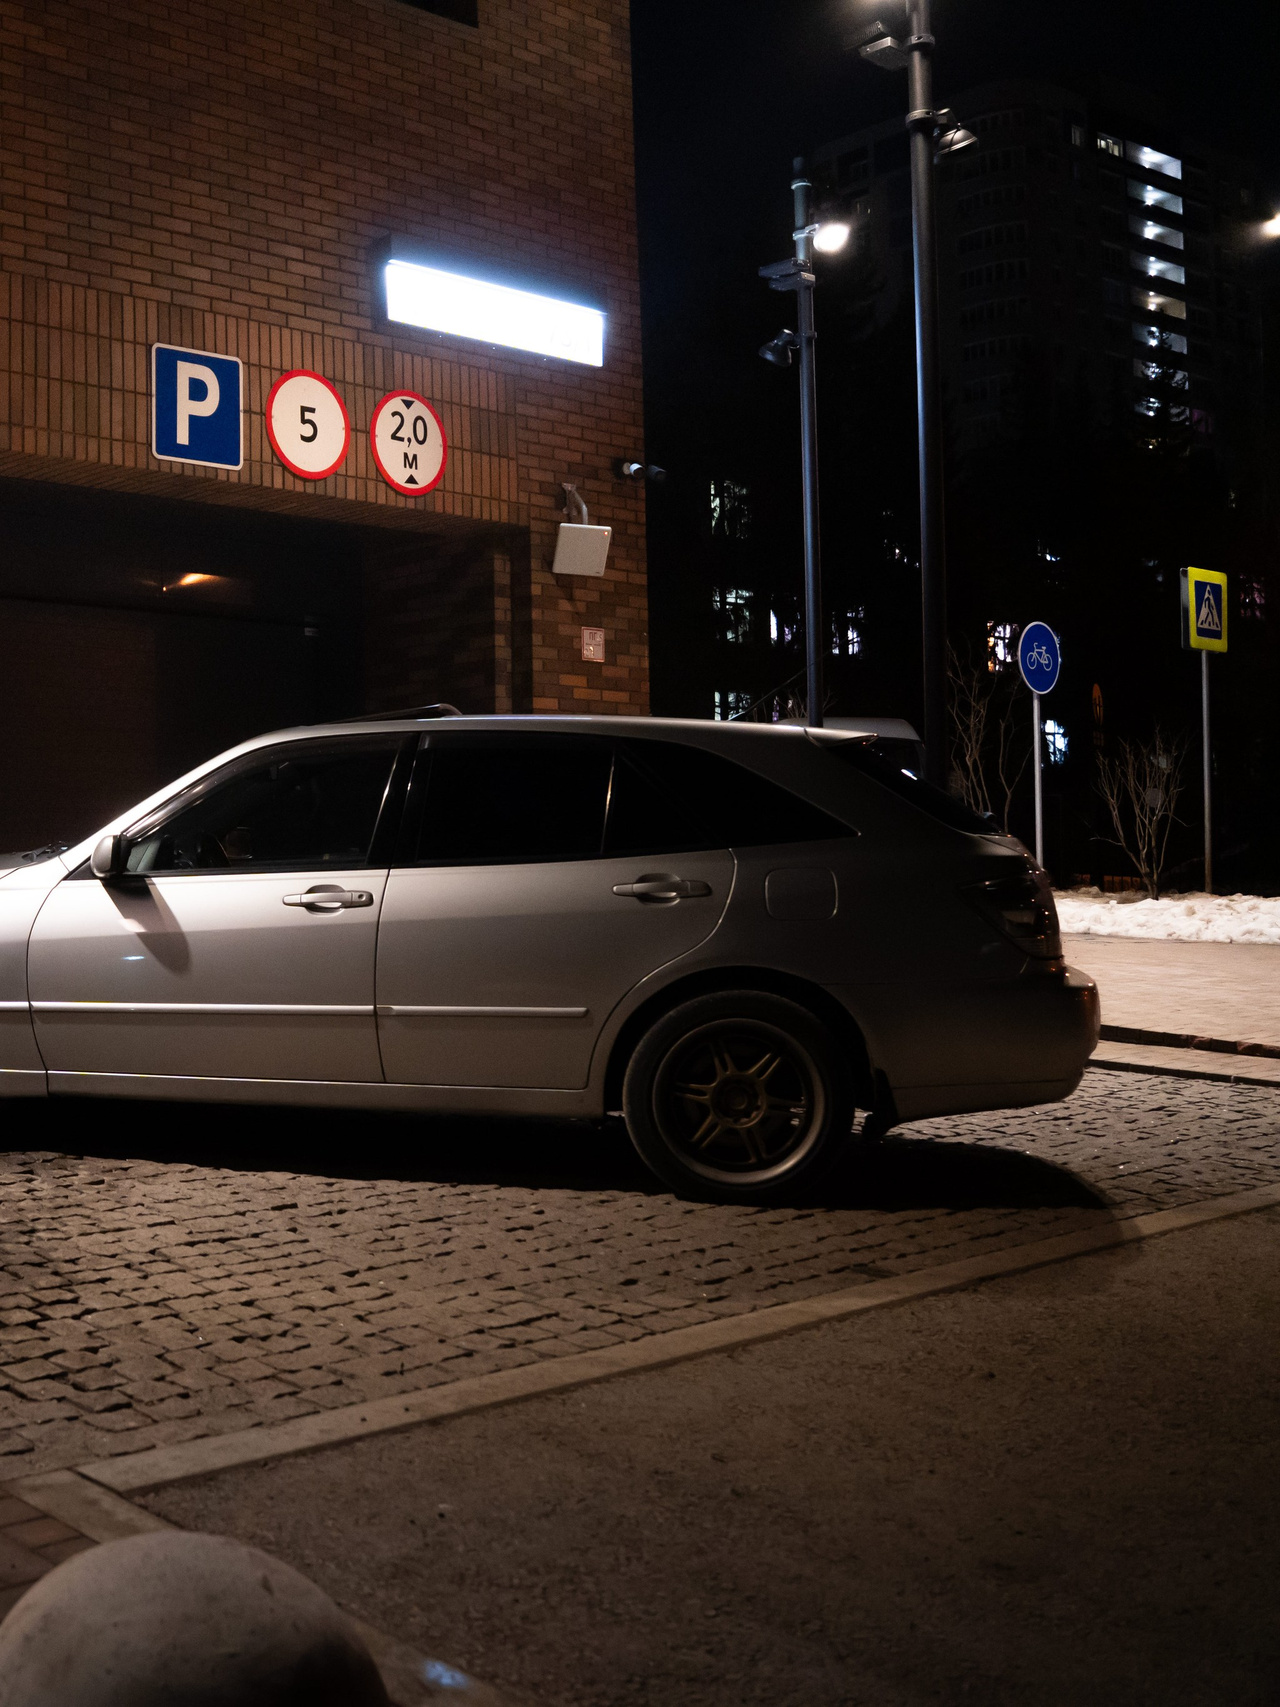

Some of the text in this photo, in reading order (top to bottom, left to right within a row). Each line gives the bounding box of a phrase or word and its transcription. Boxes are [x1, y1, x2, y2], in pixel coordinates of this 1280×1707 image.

[176, 360, 220, 446] P
[299, 405, 318, 443] 5
[390, 410, 428, 448] 2,0
